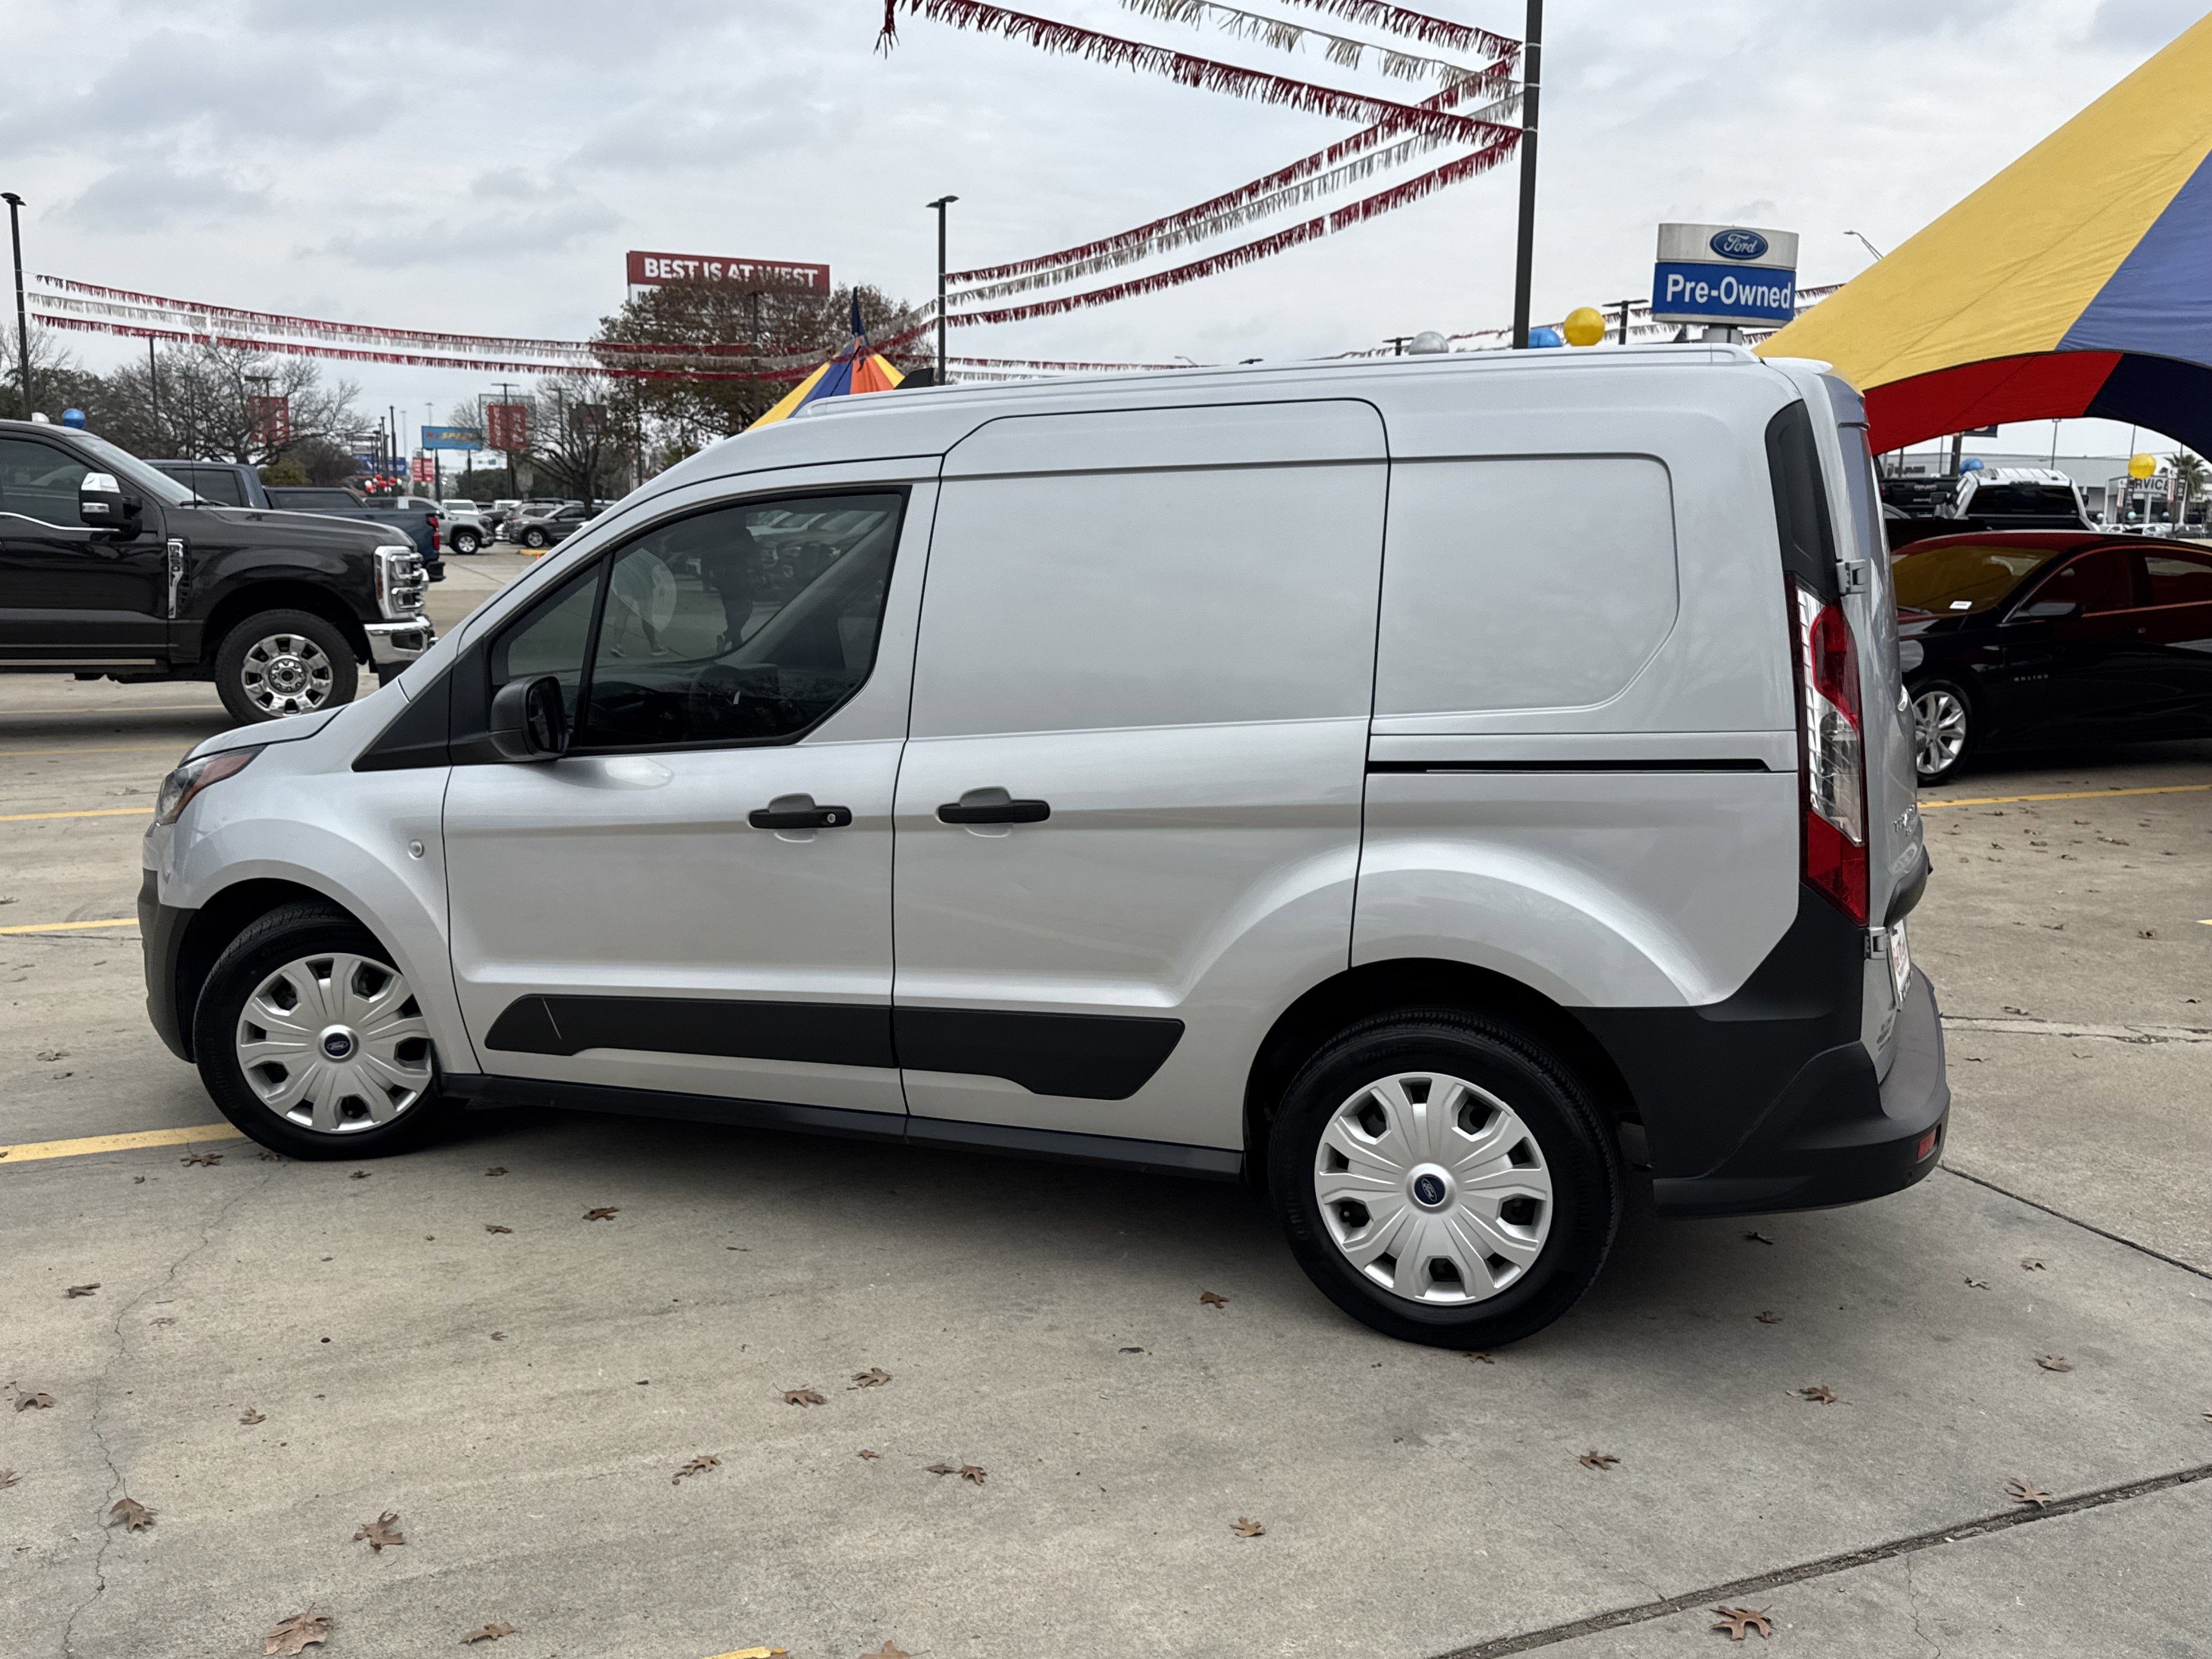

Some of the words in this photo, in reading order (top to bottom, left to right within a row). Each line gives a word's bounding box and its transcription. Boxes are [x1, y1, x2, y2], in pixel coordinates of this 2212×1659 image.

[1723, 234, 1757, 254] Ford
[644, 257, 699, 280] BEST
[703, 262, 723, 282] IS
[727, 263, 754, 283] AT
[1666, 274, 1791, 309] Pre-Owned
